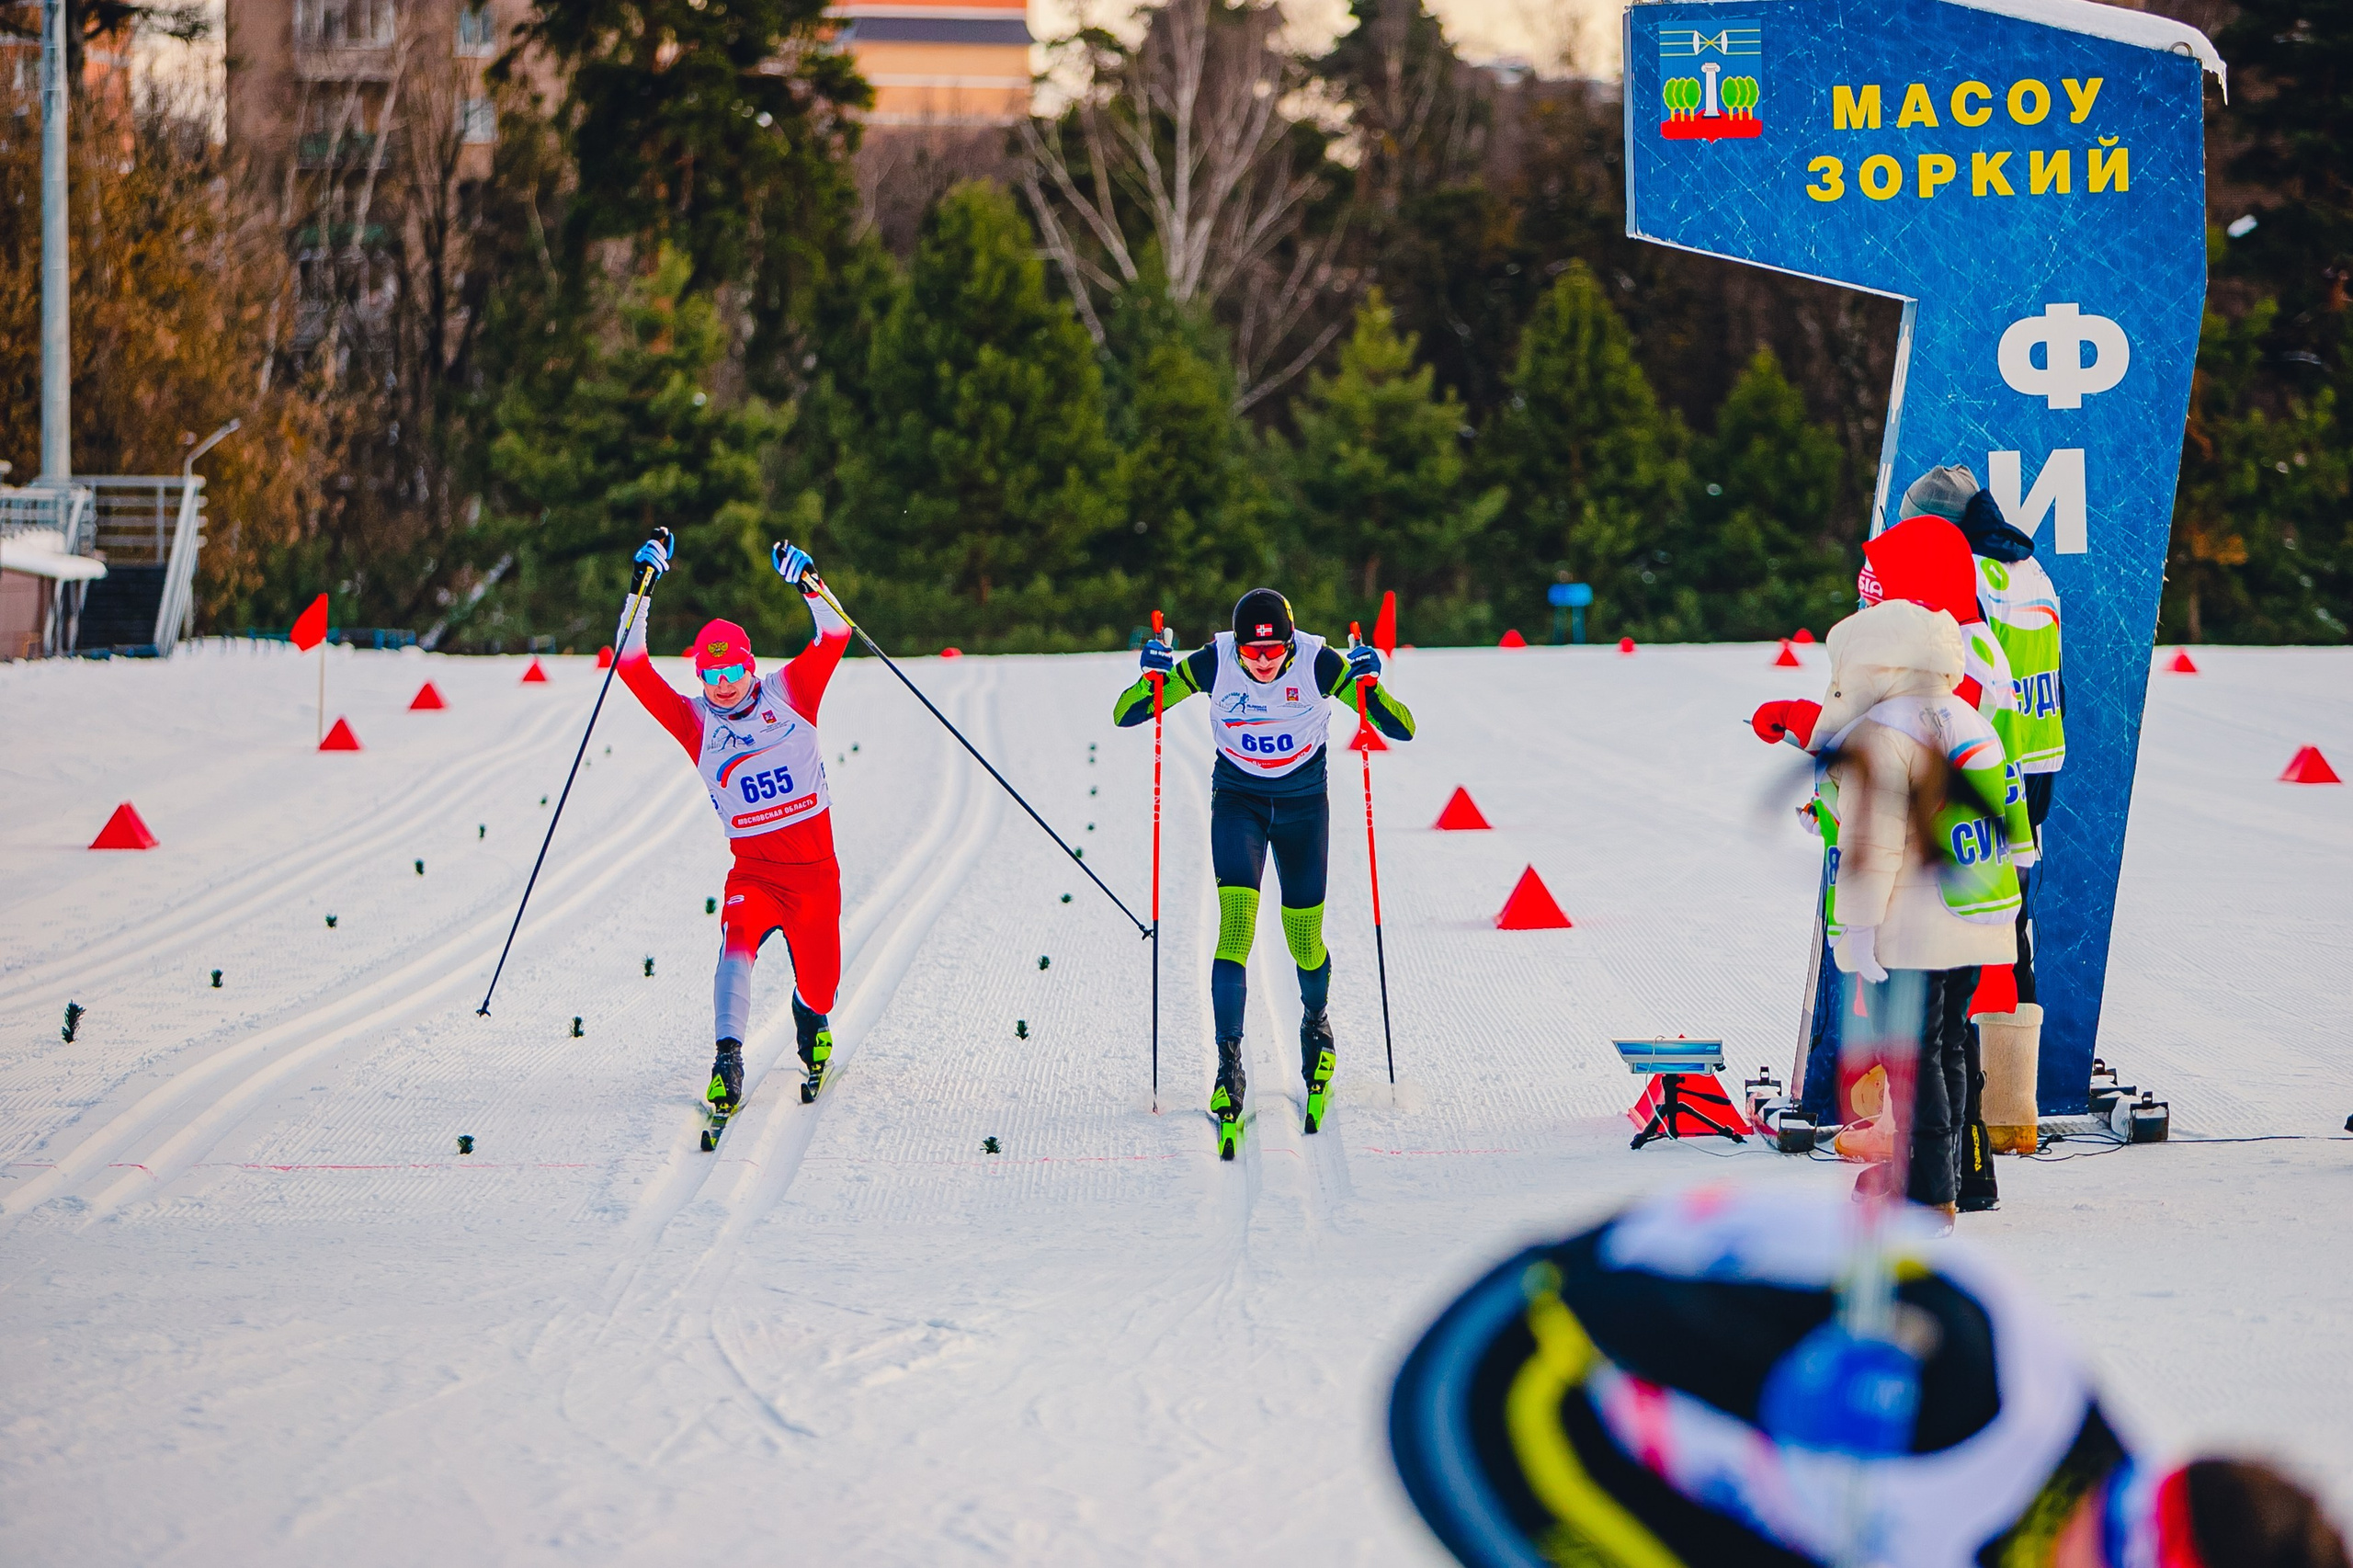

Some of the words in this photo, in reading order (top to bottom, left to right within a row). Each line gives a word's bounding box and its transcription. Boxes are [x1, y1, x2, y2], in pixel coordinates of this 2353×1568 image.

[1832, 77, 2104, 131] МАСОУ
[1806, 135, 2131, 203] ЗОРКИЙ
[1242, 733, 1294, 754] 650
[740, 766, 794, 804] 655
[737, 809, 783, 825] МОСКОВСКАЯ
[784, 799, 814, 814] ОБЛАСТЬ
